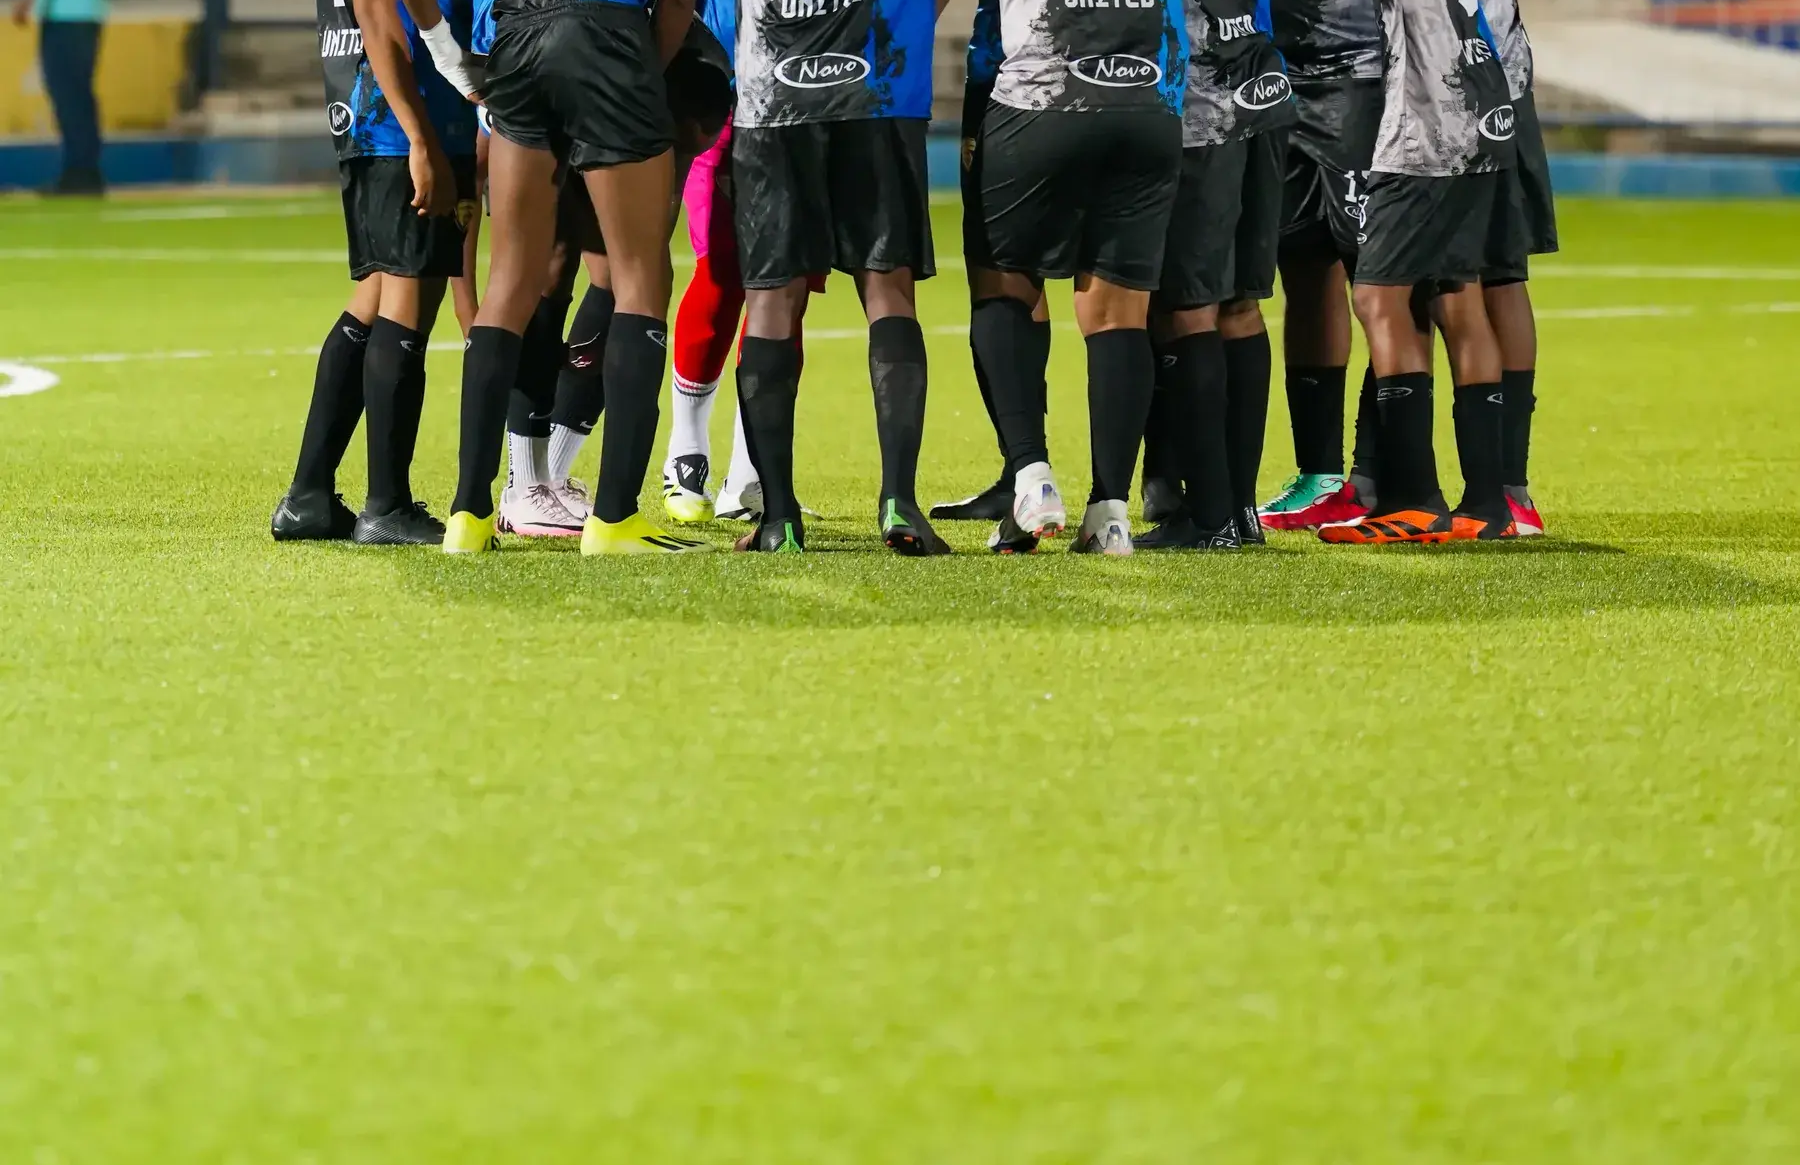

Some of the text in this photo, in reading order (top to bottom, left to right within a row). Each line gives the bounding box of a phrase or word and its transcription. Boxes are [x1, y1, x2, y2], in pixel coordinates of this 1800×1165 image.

[799, 58, 857, 83] Novo
[1095, 57, 1151, 80] Novo
[1253, 78, 1286, 105] Novo
